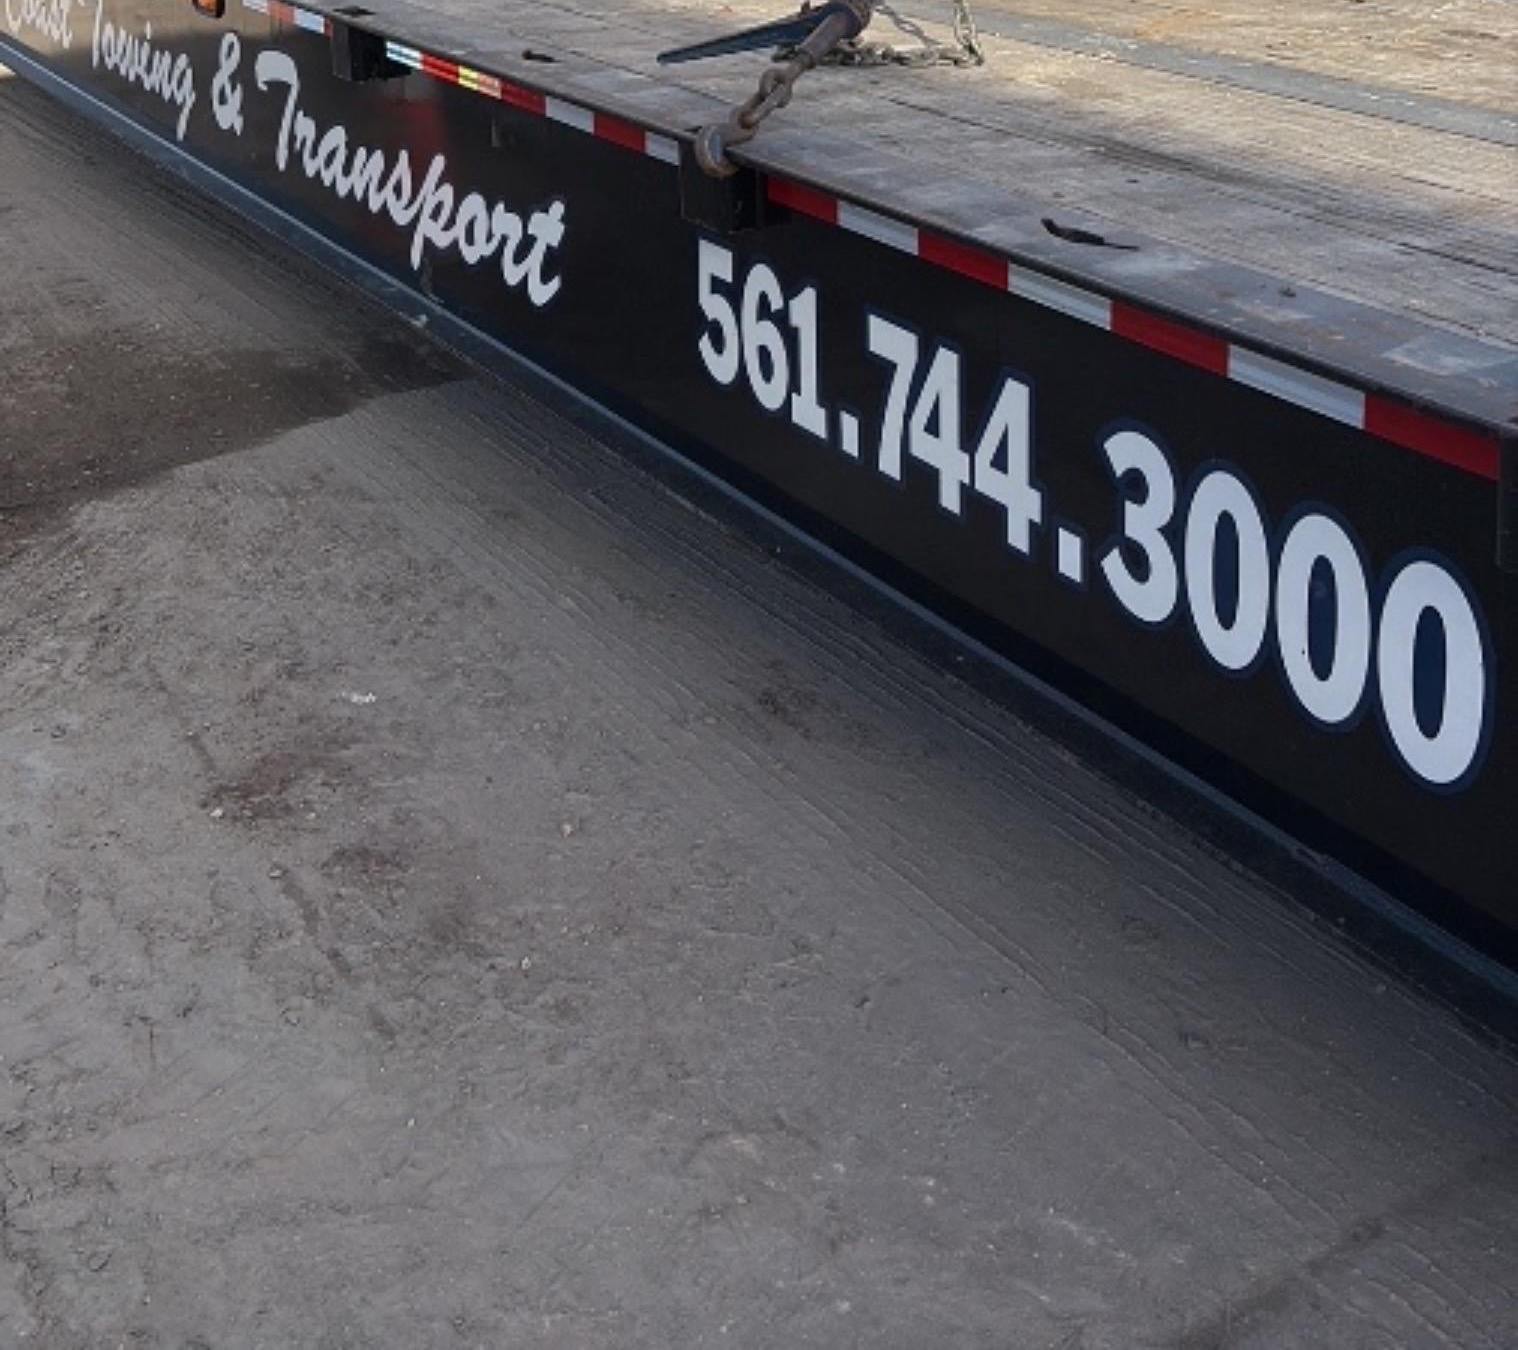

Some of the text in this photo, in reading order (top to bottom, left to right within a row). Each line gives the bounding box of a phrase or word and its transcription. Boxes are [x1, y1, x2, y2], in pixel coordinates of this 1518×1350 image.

[211, 32, 244, 137] &
[255, 51, 566, 306] Transport
[697, 238, 1485, 785] 561.744.3000
